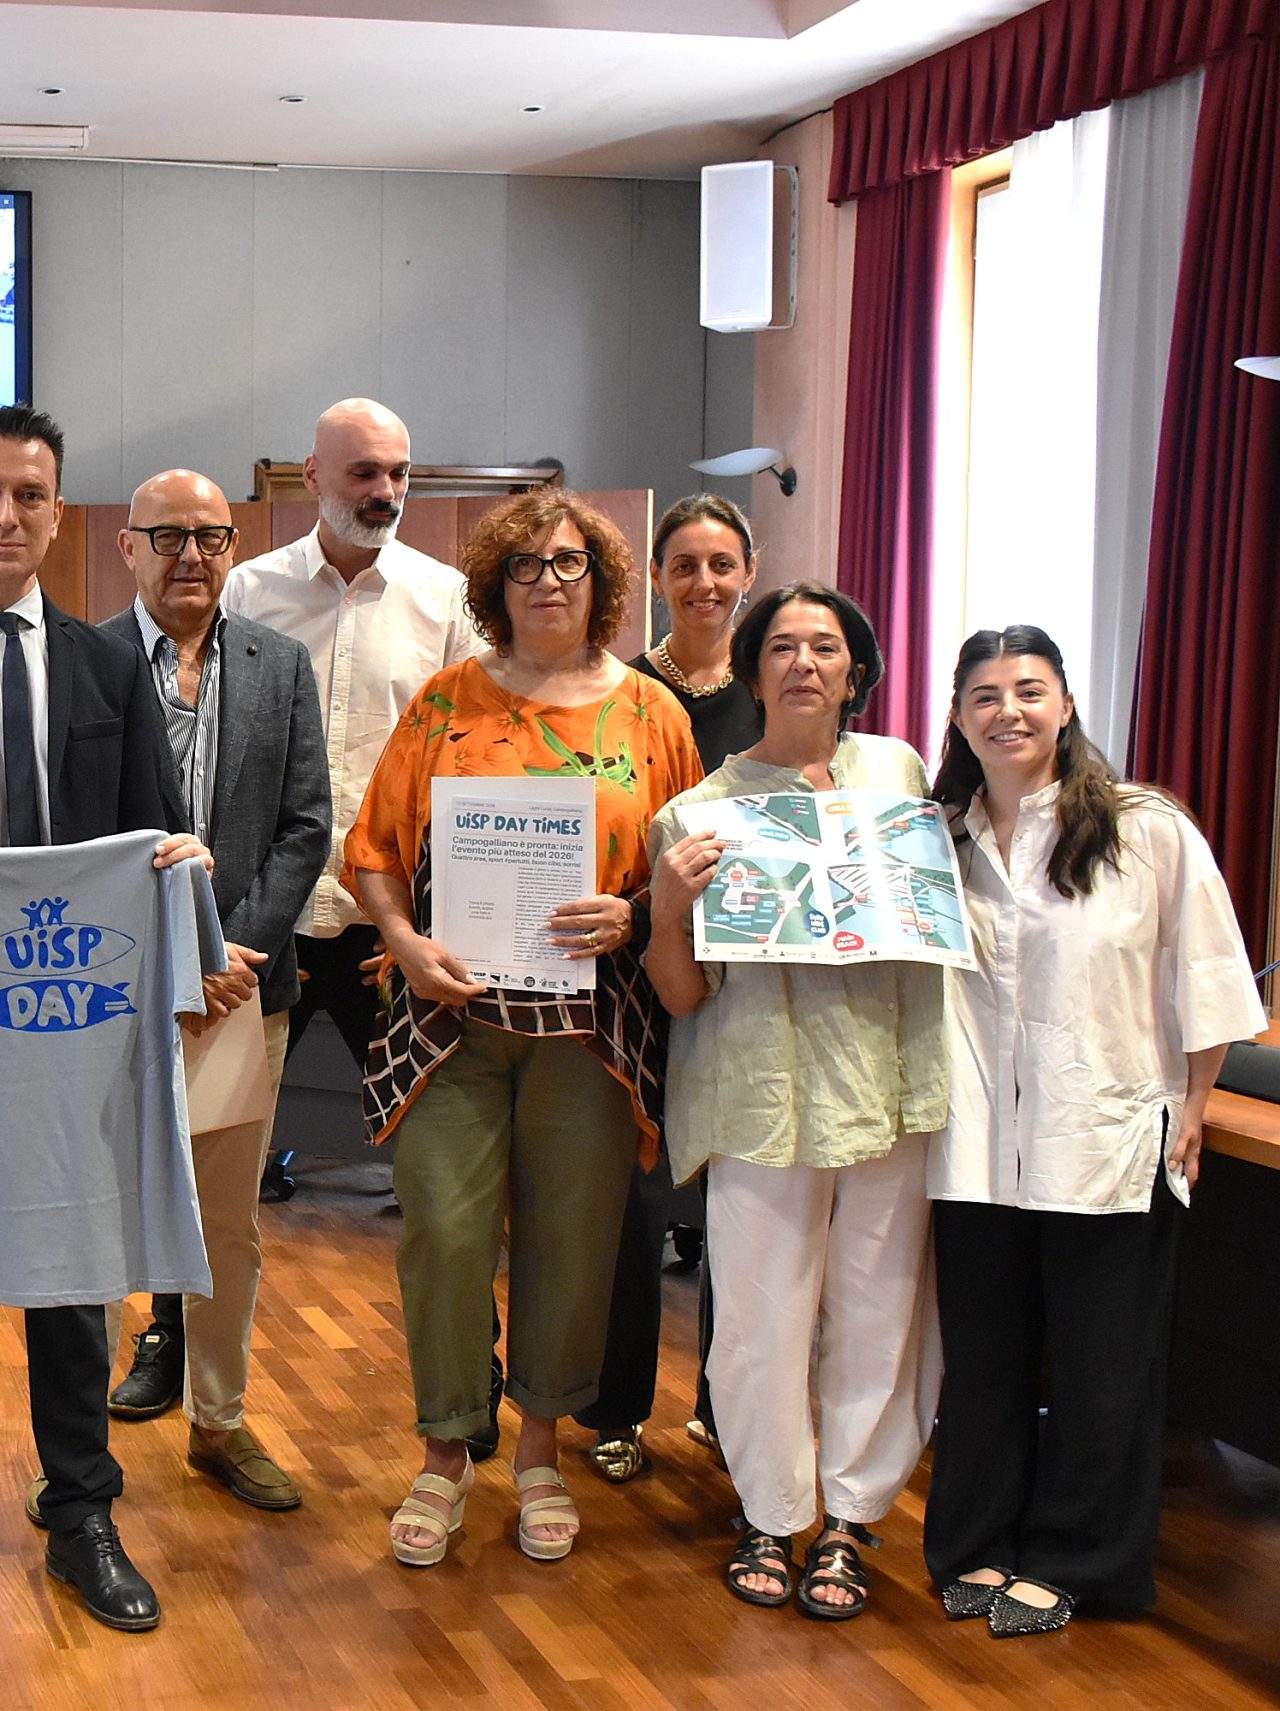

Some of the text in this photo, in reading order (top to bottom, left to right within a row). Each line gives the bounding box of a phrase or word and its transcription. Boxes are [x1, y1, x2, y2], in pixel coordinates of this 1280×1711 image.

[494, 815, 528, 832] DAY
[452, 836, 584, 852] Campogalliano è pronta: inizia
[488, 847, 502, 857] più
[503, 849, 531, 858] atteso
[532, 850, 547, 858] del
[548, 851, 575, 860] 2026!
[6, 982, 95, 1029] DAY
